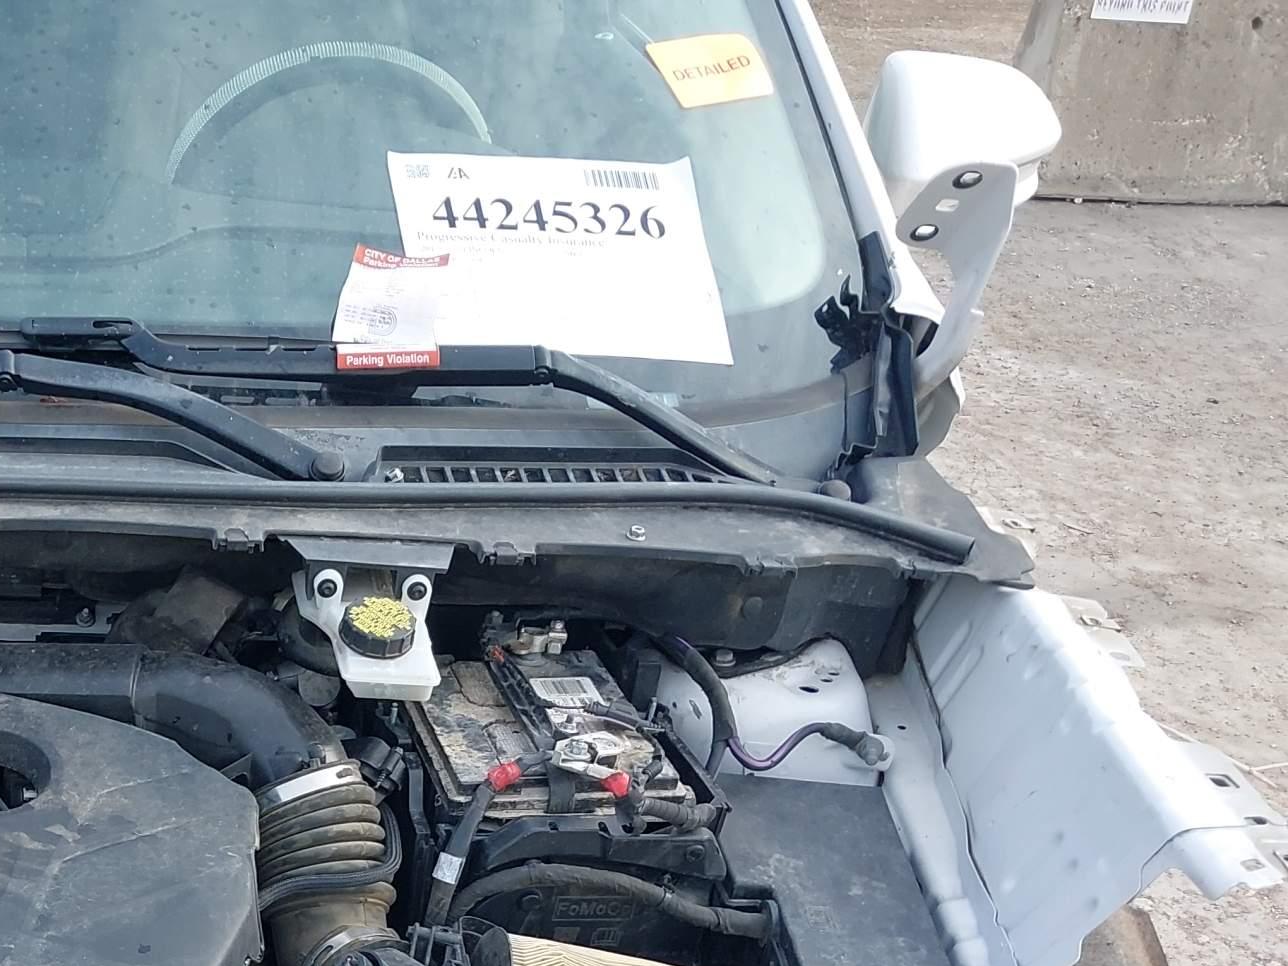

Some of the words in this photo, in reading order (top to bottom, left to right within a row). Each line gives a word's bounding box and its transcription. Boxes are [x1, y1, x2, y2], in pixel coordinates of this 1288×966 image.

[672, 54, 752, 81] DETAILED
[432, 196, 667, 240] 44245326
[364, 248, 386, 261] CITY
[346, 355, 384, 367] Parking
[386, 353, 430, 365] Violation
